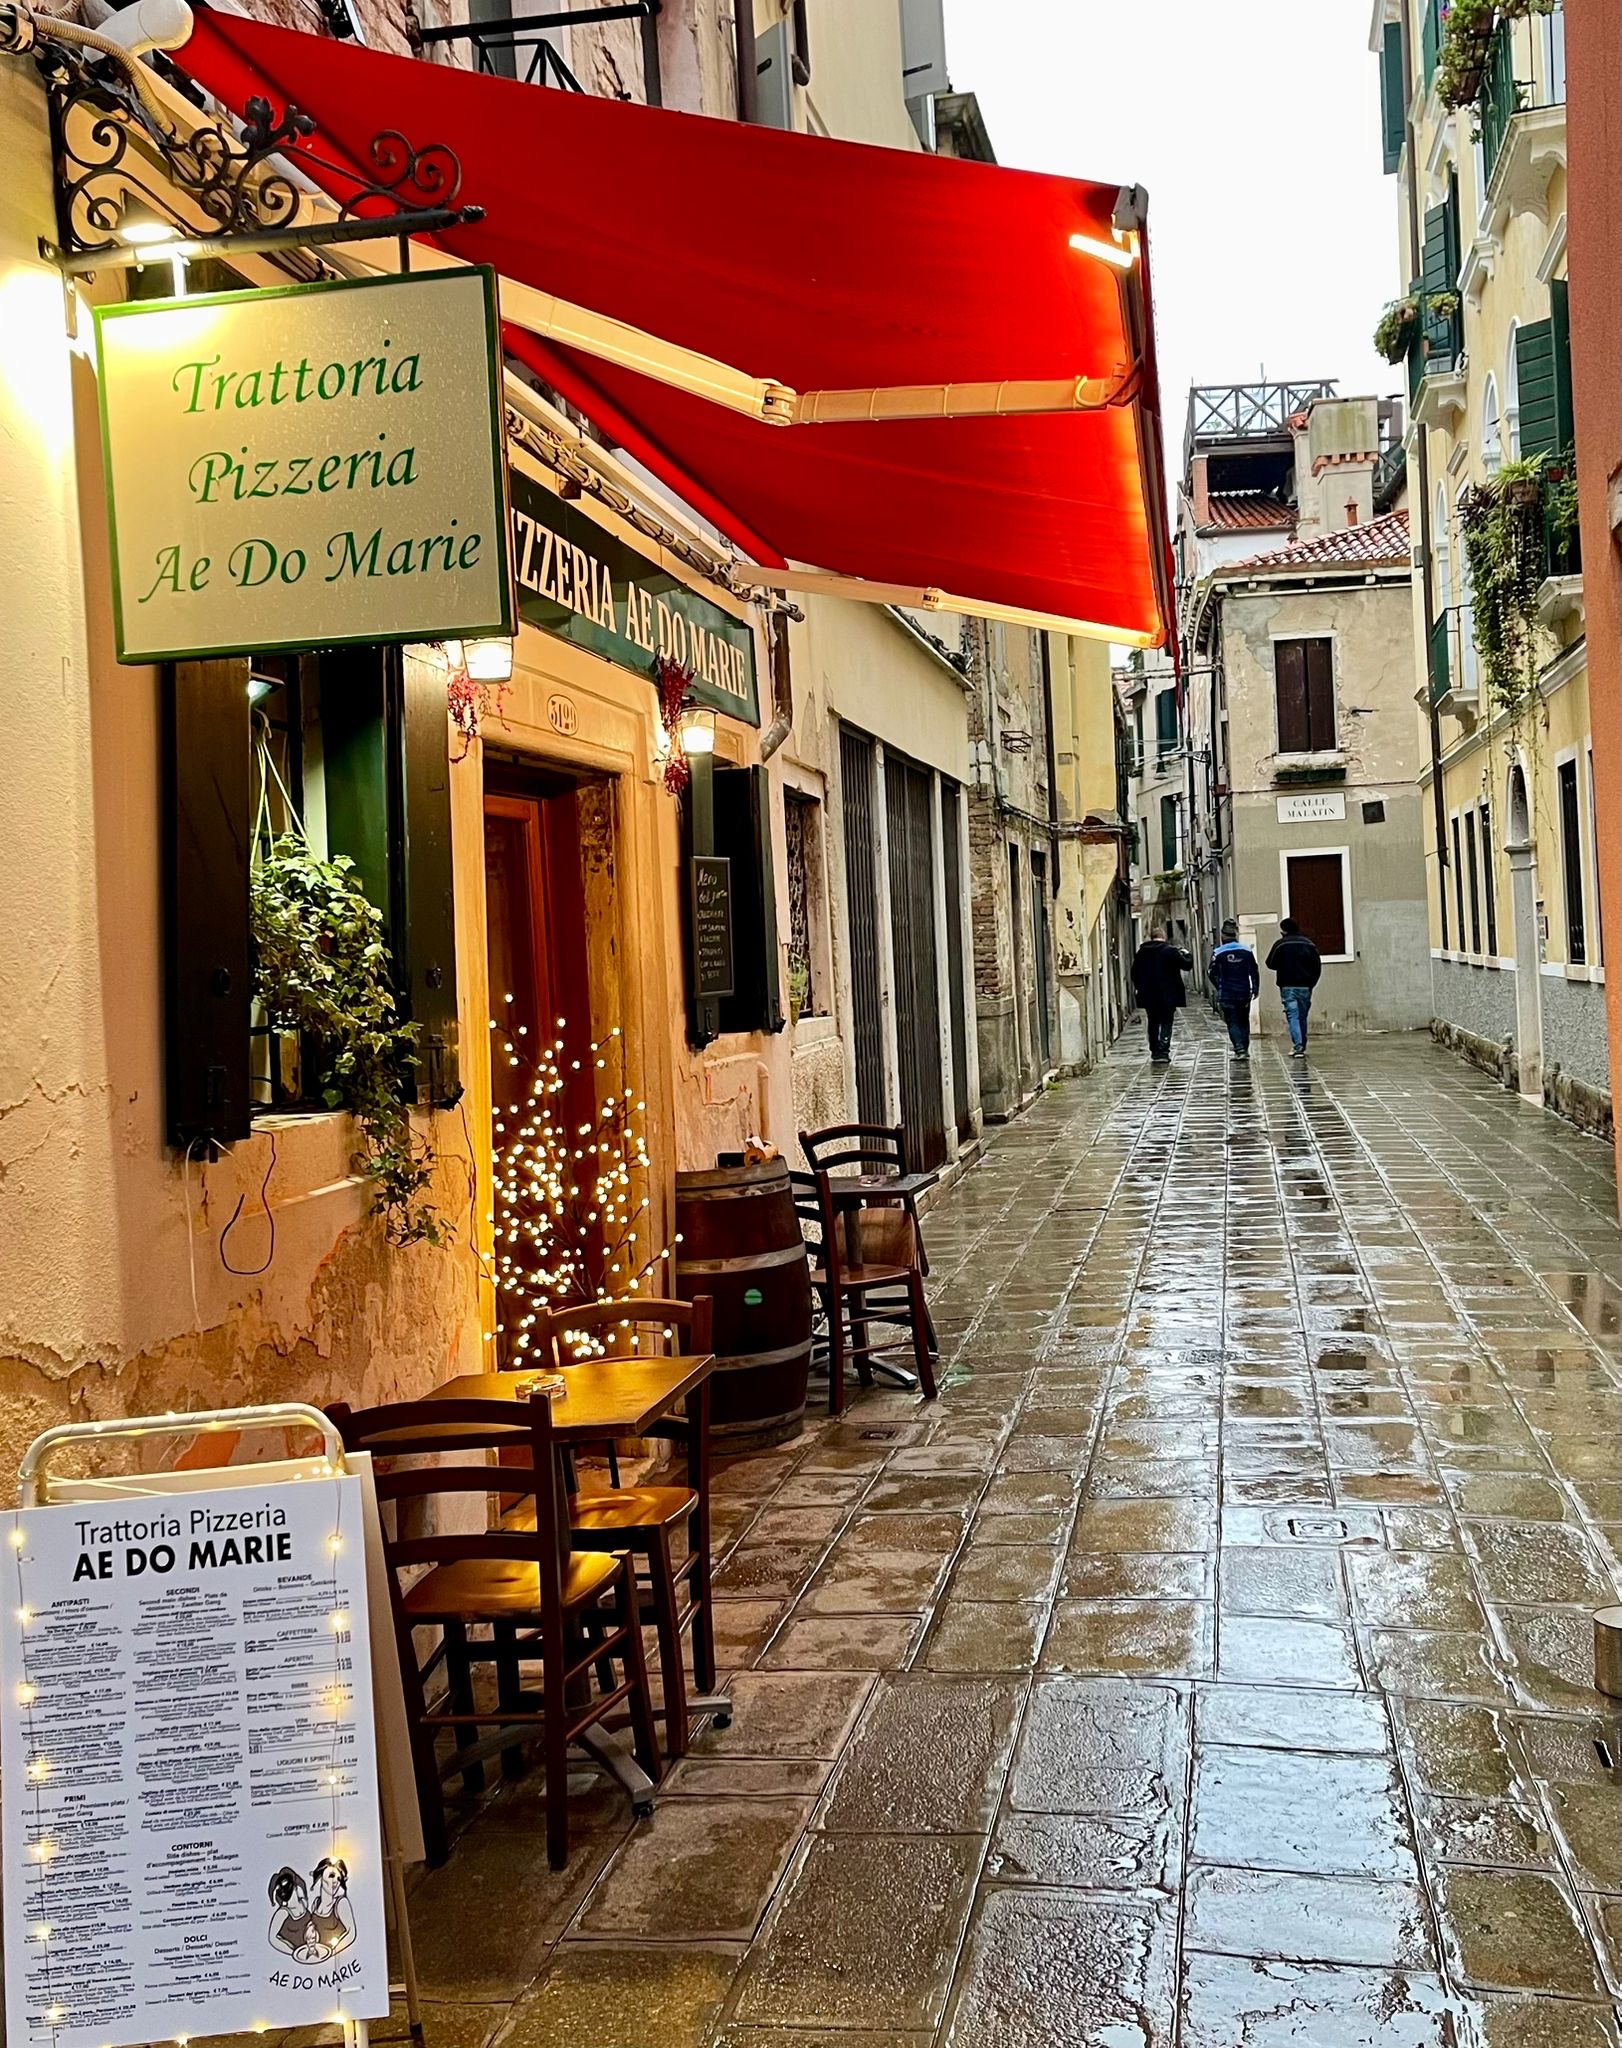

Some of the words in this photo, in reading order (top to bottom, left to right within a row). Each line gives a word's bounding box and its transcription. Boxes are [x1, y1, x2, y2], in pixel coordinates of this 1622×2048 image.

[173, 339, 423, 413] Trattoria
[188, 433, 419, 504] Pizzeria
[138, 544, 211, 603] Ae
[228, 538, 307, 588] Do
[325, 519, 482, 583] Marie
[625, 580, 654, 654] AE
[657, 599, 687, 669] DO
[689, 620, 748, 701] MARIE
[1293, 798, 1328, 808] CALLE
[1287, 807, 1335, 818] MALATIN
[75, 1514, 180, 1546] Trattoria
[190, 1503, 286, 1534] Pizzeria
[72, 1551, 113, 1582] AE
[127, 1544, 176, 1577] DO
[188, 1532, 292, 1570] MARIE
[277, 1574, 312, 1584] BEVANDE
[166, 1587, 200, 1596] SECONDI
[51, 1598, 90, 1608] ANTIPASTI
[64, 1795, 86, 1803] PRIMI
[171, 1841, 213, 1851] CONTORNI
[183, 1934, 208, 1944] DOLCI
[269, 1971, 290, 1987] AE
[292, 1975, 313, 1990] DO
[317, 1959, 362, 1988] MARIE
